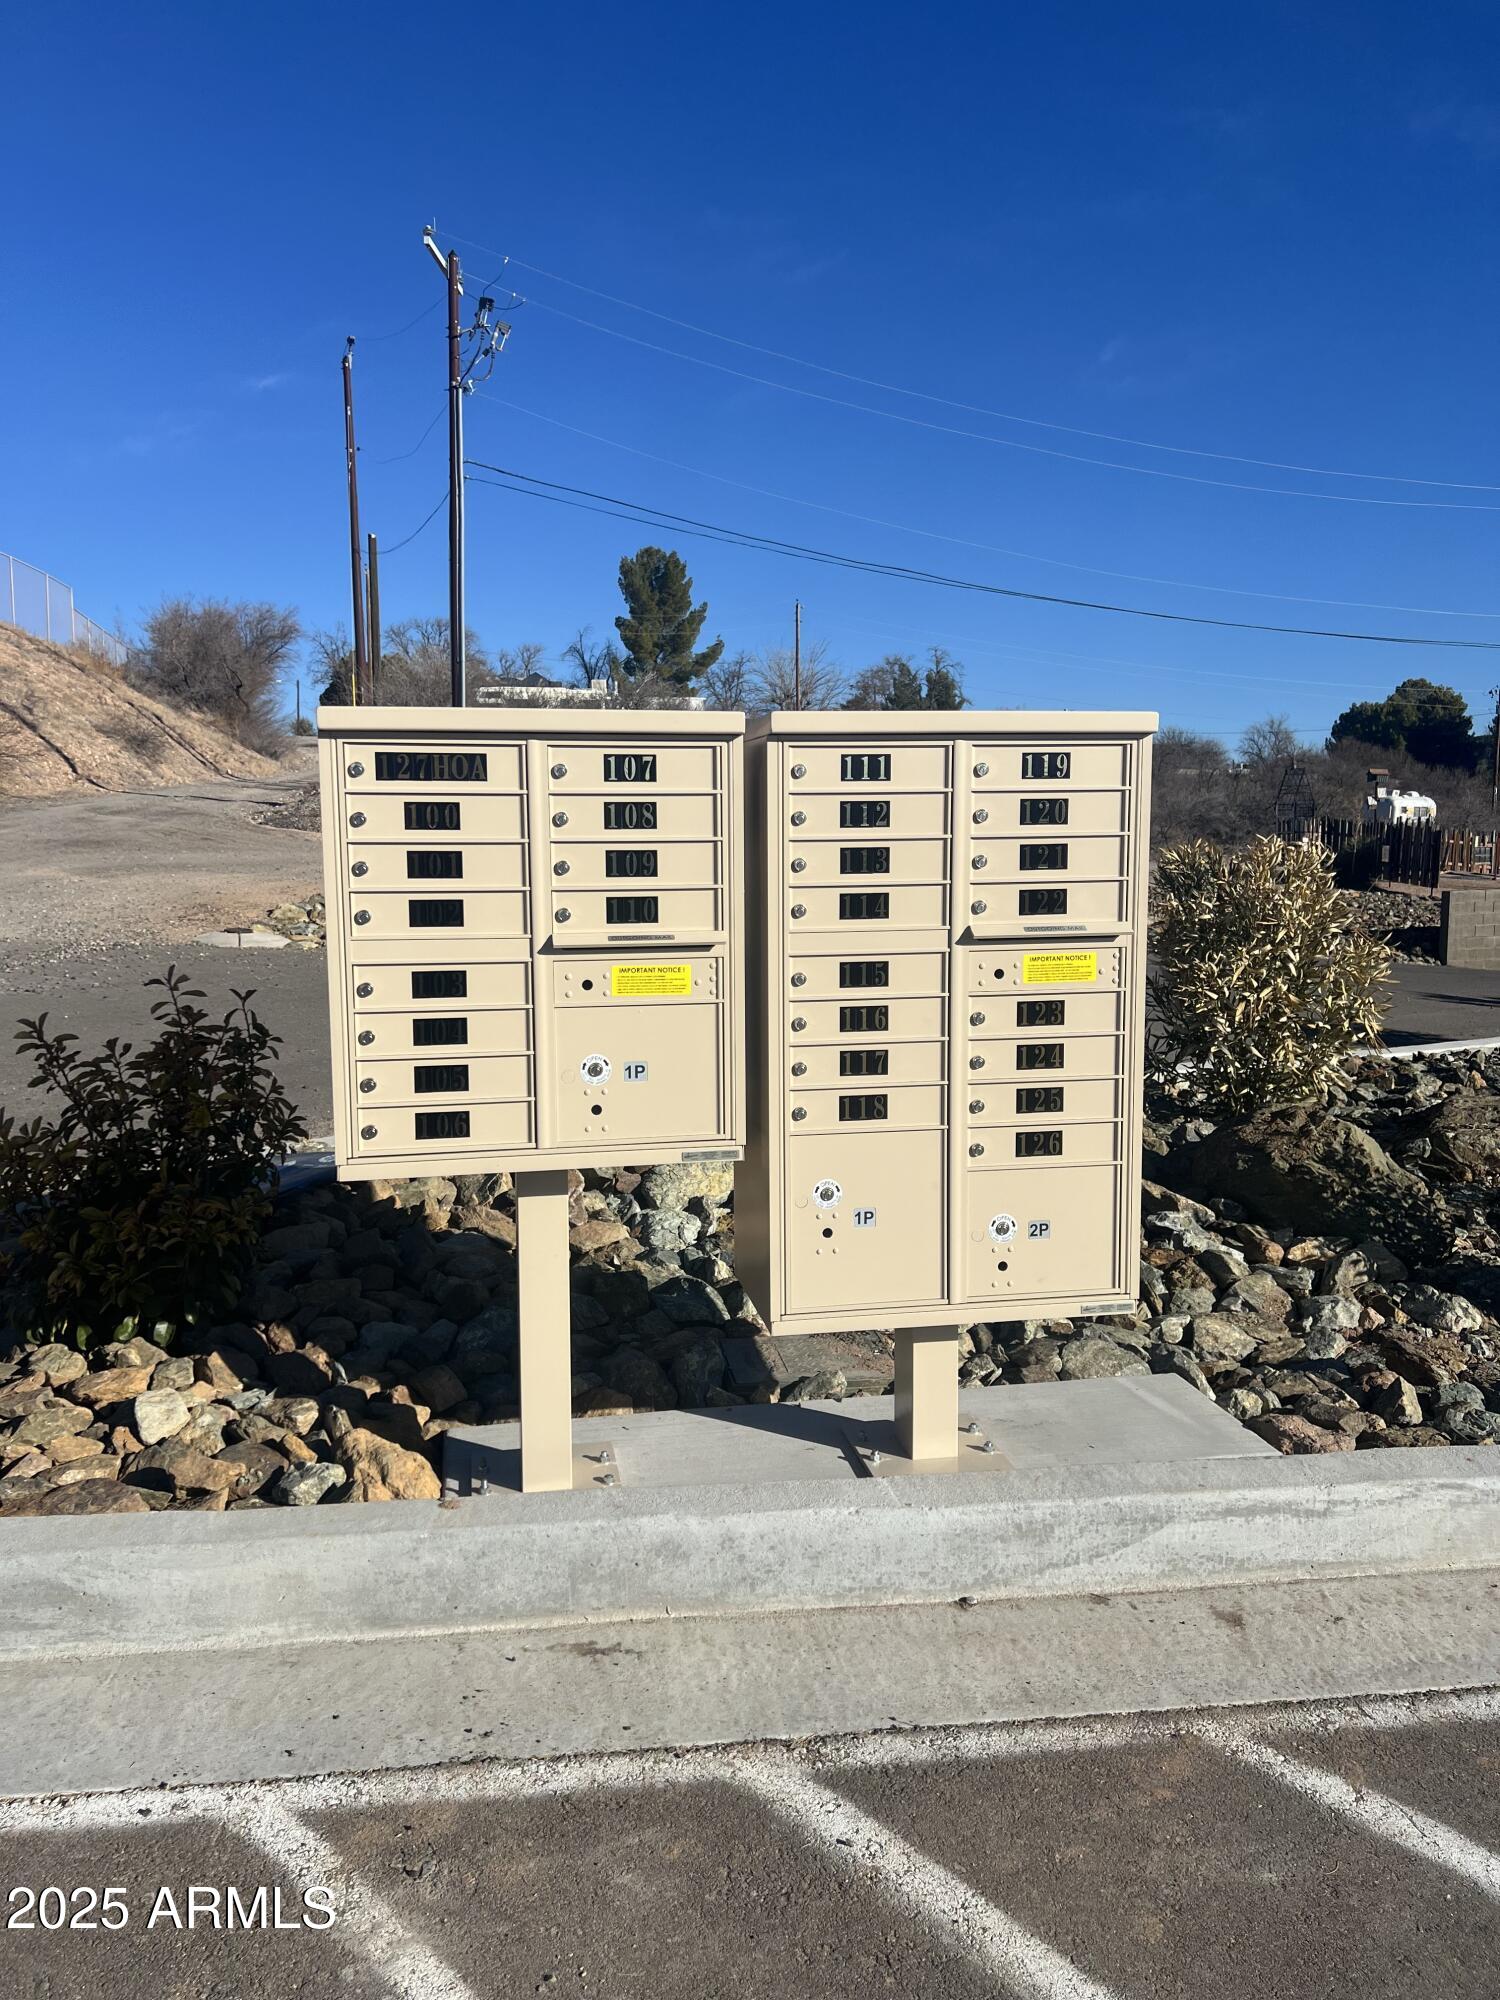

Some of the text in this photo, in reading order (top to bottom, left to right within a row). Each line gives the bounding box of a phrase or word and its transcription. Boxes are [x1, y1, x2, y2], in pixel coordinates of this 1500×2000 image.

[379, 754, 486, 780] 127HOA
[607, 756, 654, 781] 107
[844, 756, 887, 780] 111
[1025, 754, 1068, 778] 119
[407, 803, 458, 829] 100
[608, 803, 654, 828] 108
[843, 802, 888, 826] 112
[1024, 800, 1066, 823] 120
[409, 853, 461, 877] 101
[609, 852, 655, 876] 109
[844, 849, 887, 873] 113
[1023, 845, 1063, 868] 121
[610, 899, 655, 922] 110
[844, 894, 887, 918] 114
[1023, 891, 1064, 914] 122
[843, 963, 886, 986] 115
[843, 1007, 886, 1030] 116
[1020, 1002, 1062, 1025] 123
[587, 1055, 603, 1063] OPEN
[843, 1051, 886, 1074] 117
[1020, 1045, 1062, 1069] 124
[625, 1065, 645, 1079] 1P
[843, 1096, 885, 1119] 118
[1020, 1088, 1061, 1112] 125
[418, 1113, 467, 1138] 106
[1019, 1131, 1060, 1155] 126
[854, 1211, 874, 1225] 1P
[1030, 1223, 1049, 1237] 2P
